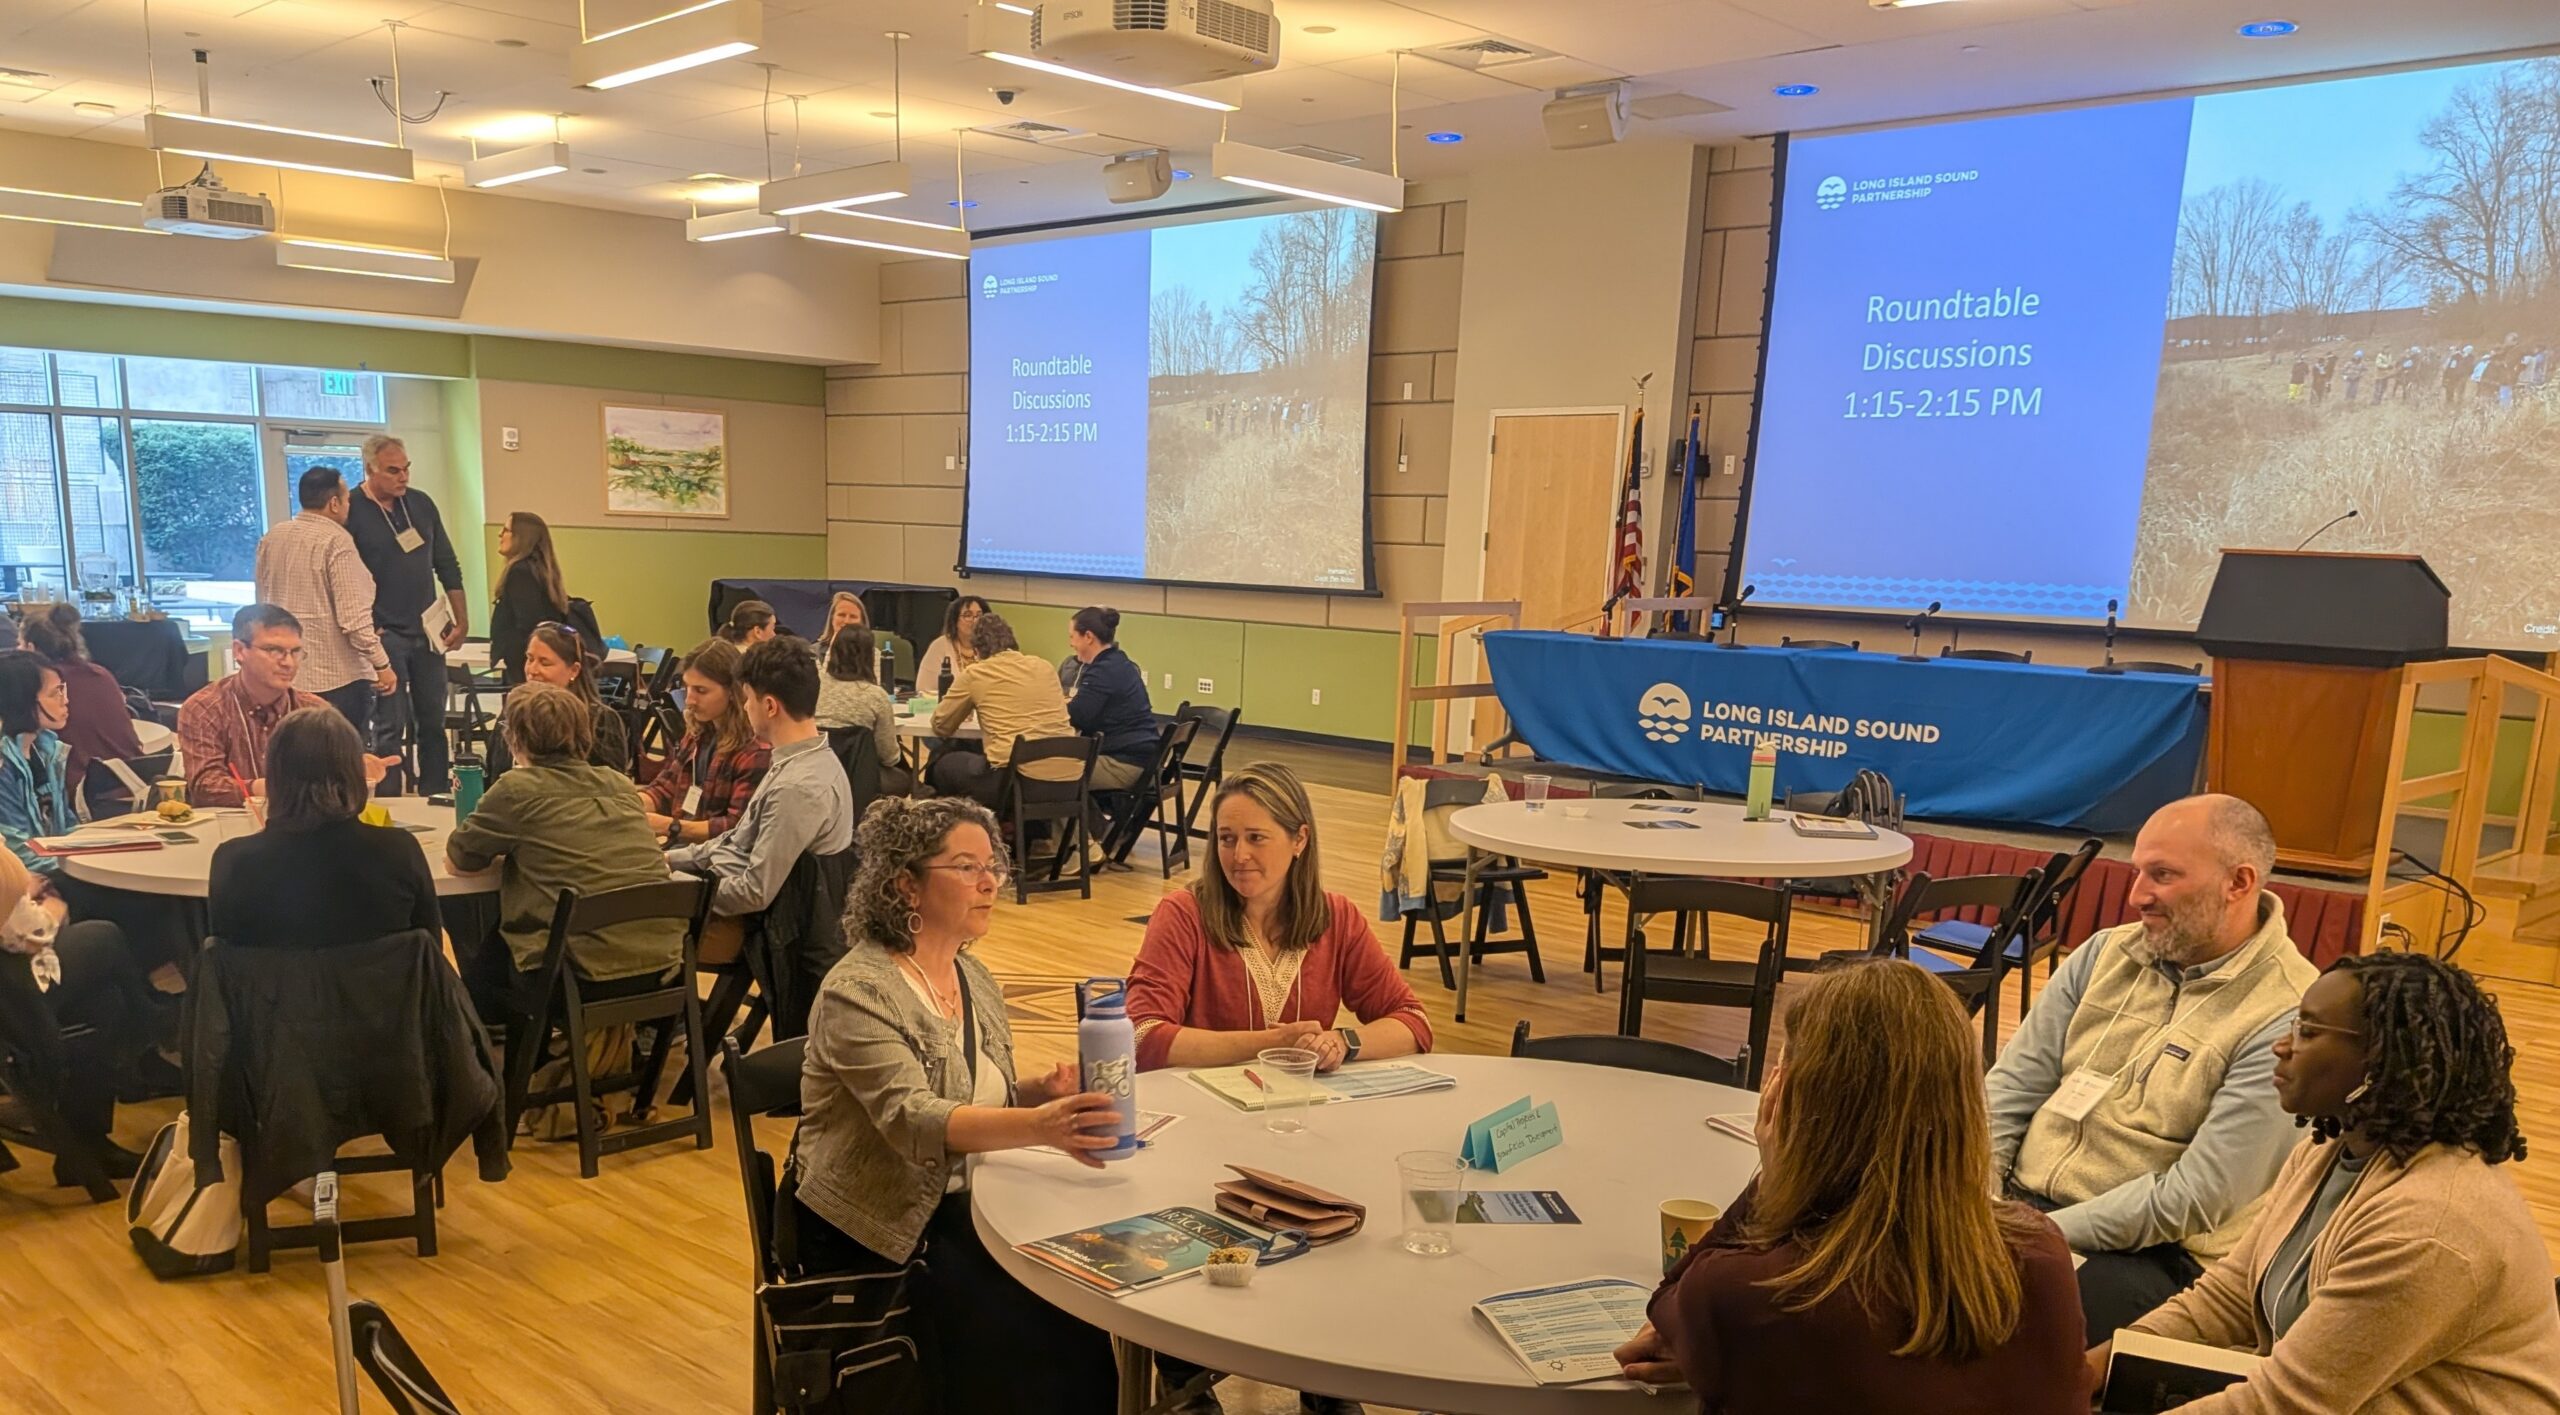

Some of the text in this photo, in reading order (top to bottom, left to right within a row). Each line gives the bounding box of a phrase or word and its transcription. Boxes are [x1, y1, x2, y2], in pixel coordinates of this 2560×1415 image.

[1853, 170, 1979, 192] LONG ISLAND SOUND
[1852, 187, 1932, 204] PARTNERSHIP
[999, 278, 1015, 286] LONG
[999, 284, 1038, 294] PARTNERSHIP
[1866, 286, 2041, 323] Roundtable
[1012, 354, 1092, 377] Roundtable
[1862, 339, 2033, 371] Discussions
[325, 373, 357, 395] EXIT
[1012, 389, 1091, 410] Discussions
[1843, 387, 2043, 418] 1:15-2:15 PM
[1006, 422, 1098, 443] 1:15-2:15 PM
[1702, 700, 1941, 744] LONG ISLAND SOUND
[1700, 723, 1849, 759] PARTNERSHIP
